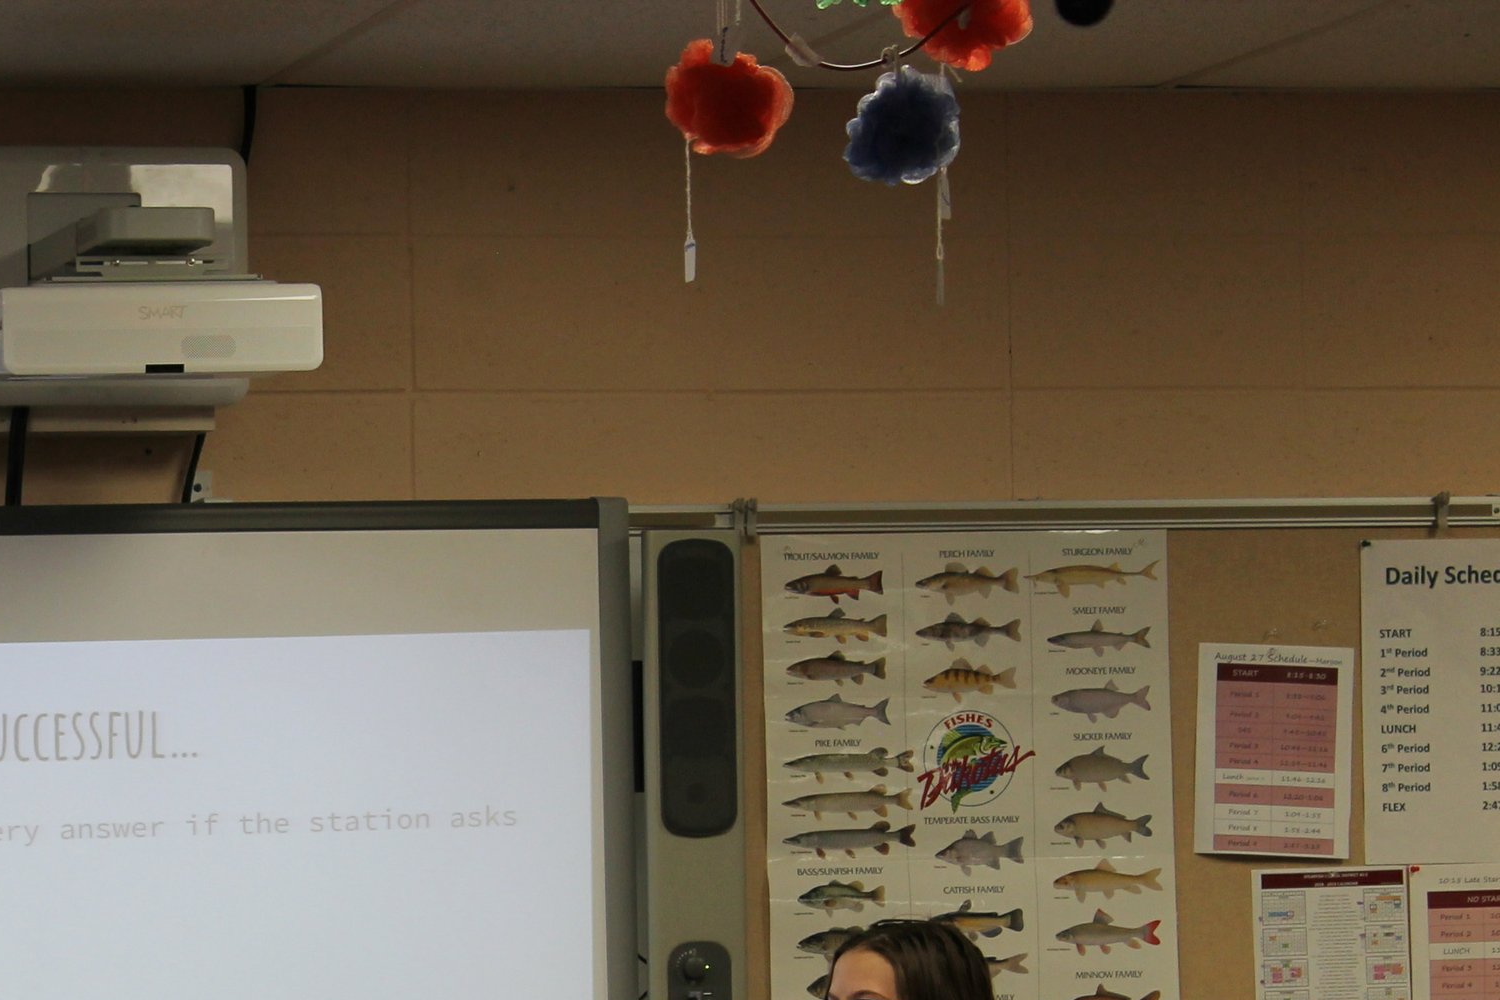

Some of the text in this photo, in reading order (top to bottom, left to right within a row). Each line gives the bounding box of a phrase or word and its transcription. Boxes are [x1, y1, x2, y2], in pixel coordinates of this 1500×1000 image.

[138, 304, 188, 320] SMART
[851, 551, 880, 560] FAMILY
[966, 549, 995, 558] FAMILY
[1105, 547, 1133, 556] FAMILY
[1385, 565, 1439, 589] Daily
[1072, 606, 1127, 615] SMELT FAMILY
[1379, 628, 1413, 639] START
[1214, 651, 1308, 665] August 27 Schedule
[1381, 648, 1393, 658] 1st
[1395, 648, 1428, 658] Period
[1065, 666, 1136, 676] MOONEYE FAMILY
[1232, 668, 1260, 678] START
[1380, 667, 1396, 678] 2nd
[1397, 667, 1431, 677] Period
[1380, 684, 1430, 695] 3rd Period
[1380, 704, 1430, 715] 4th Period
[943, 713, 994, 730] FISHES
[1381, 724, 1417, 734] LUNCH
[1073, 732, 1132, 741] SUCKER FAMILY
[815, 738, 862, 748] PIKE FAMILY
[1381, 743, 1395, 754] 6th
[1397, 743, 1430, 753] Period
[1381, 762, 1395, 773] 7th
[1397, 762, 1431, 773] Period
[1381, 782, 1395, 793] 8th
[1398, 782, 1431, 792] Period
[1382, 802, 1406, 812] FLEX
[59, 817, 165, 841] answer
[185, 812, 219, 838] if
[238, 811, 290, 837] the
[308, 807, 431, 834] station
[449, 804, 518, 829] asks
[924, 814, 1020, 826] TEMPERATE BASS FAMILY
[797, 866, 884, 877] BASS/SUNFISH FAMILY
[1464, 876, 1481, 884] Late
[943, 885, 1005, 895] CATFISH FAMILY
[1467, 895, 1480, 903] NO
[1443, 947, 1470, 955] LUNCH
[1074, 969, 1143, 980] MINNOW FAMILY
